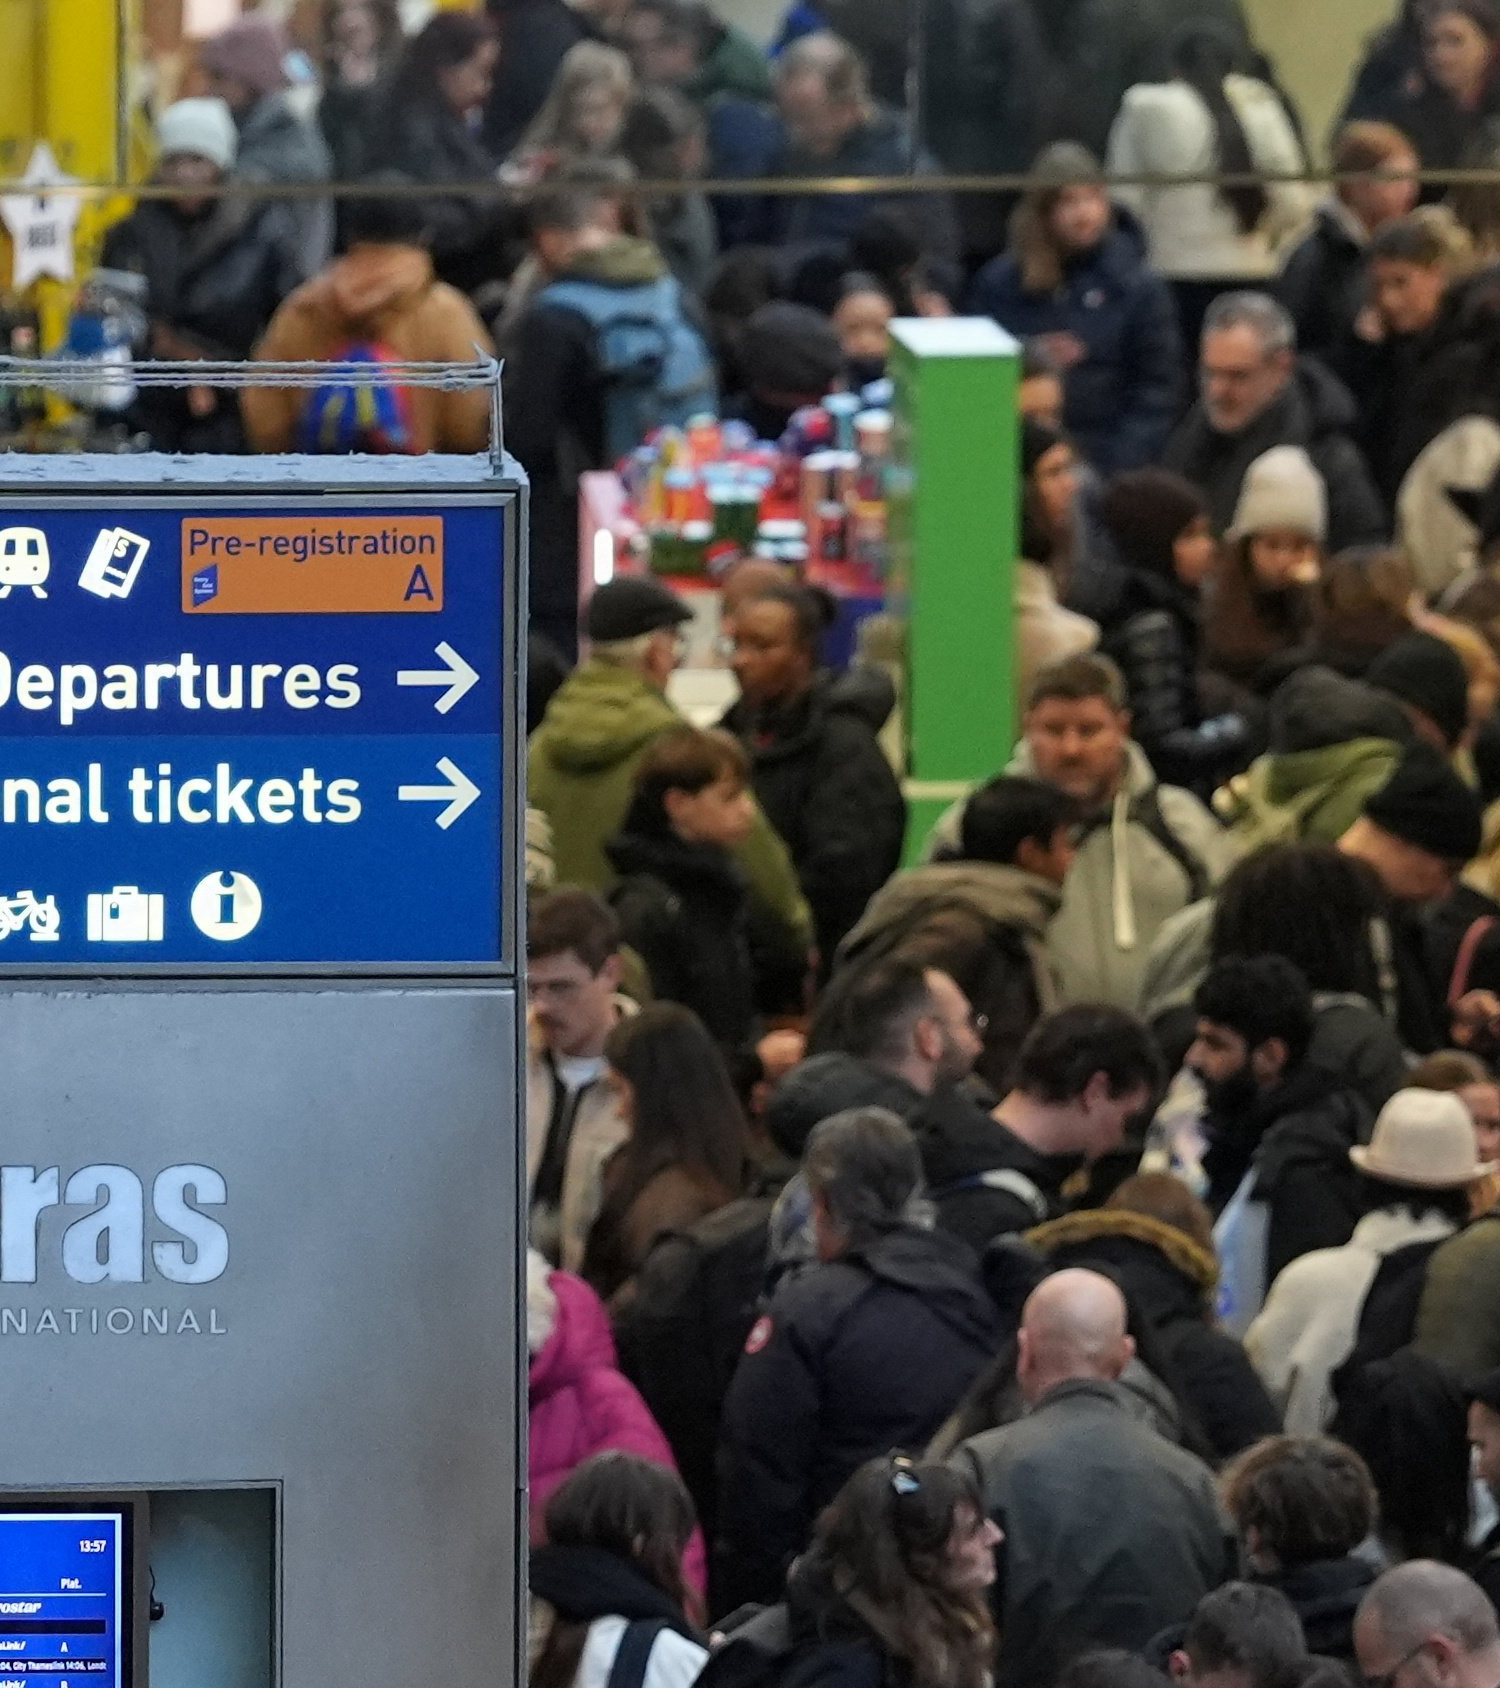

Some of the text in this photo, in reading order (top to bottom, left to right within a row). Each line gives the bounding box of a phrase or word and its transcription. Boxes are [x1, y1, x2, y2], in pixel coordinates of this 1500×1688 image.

[189, 528, 436, 563] Pre-registration
[403, 564, 435, 602] A
[128, 763, 362, 824] tickets
[79, 1539, 107, 1553] 13:57
[60, 1642, 68, 1652] A
